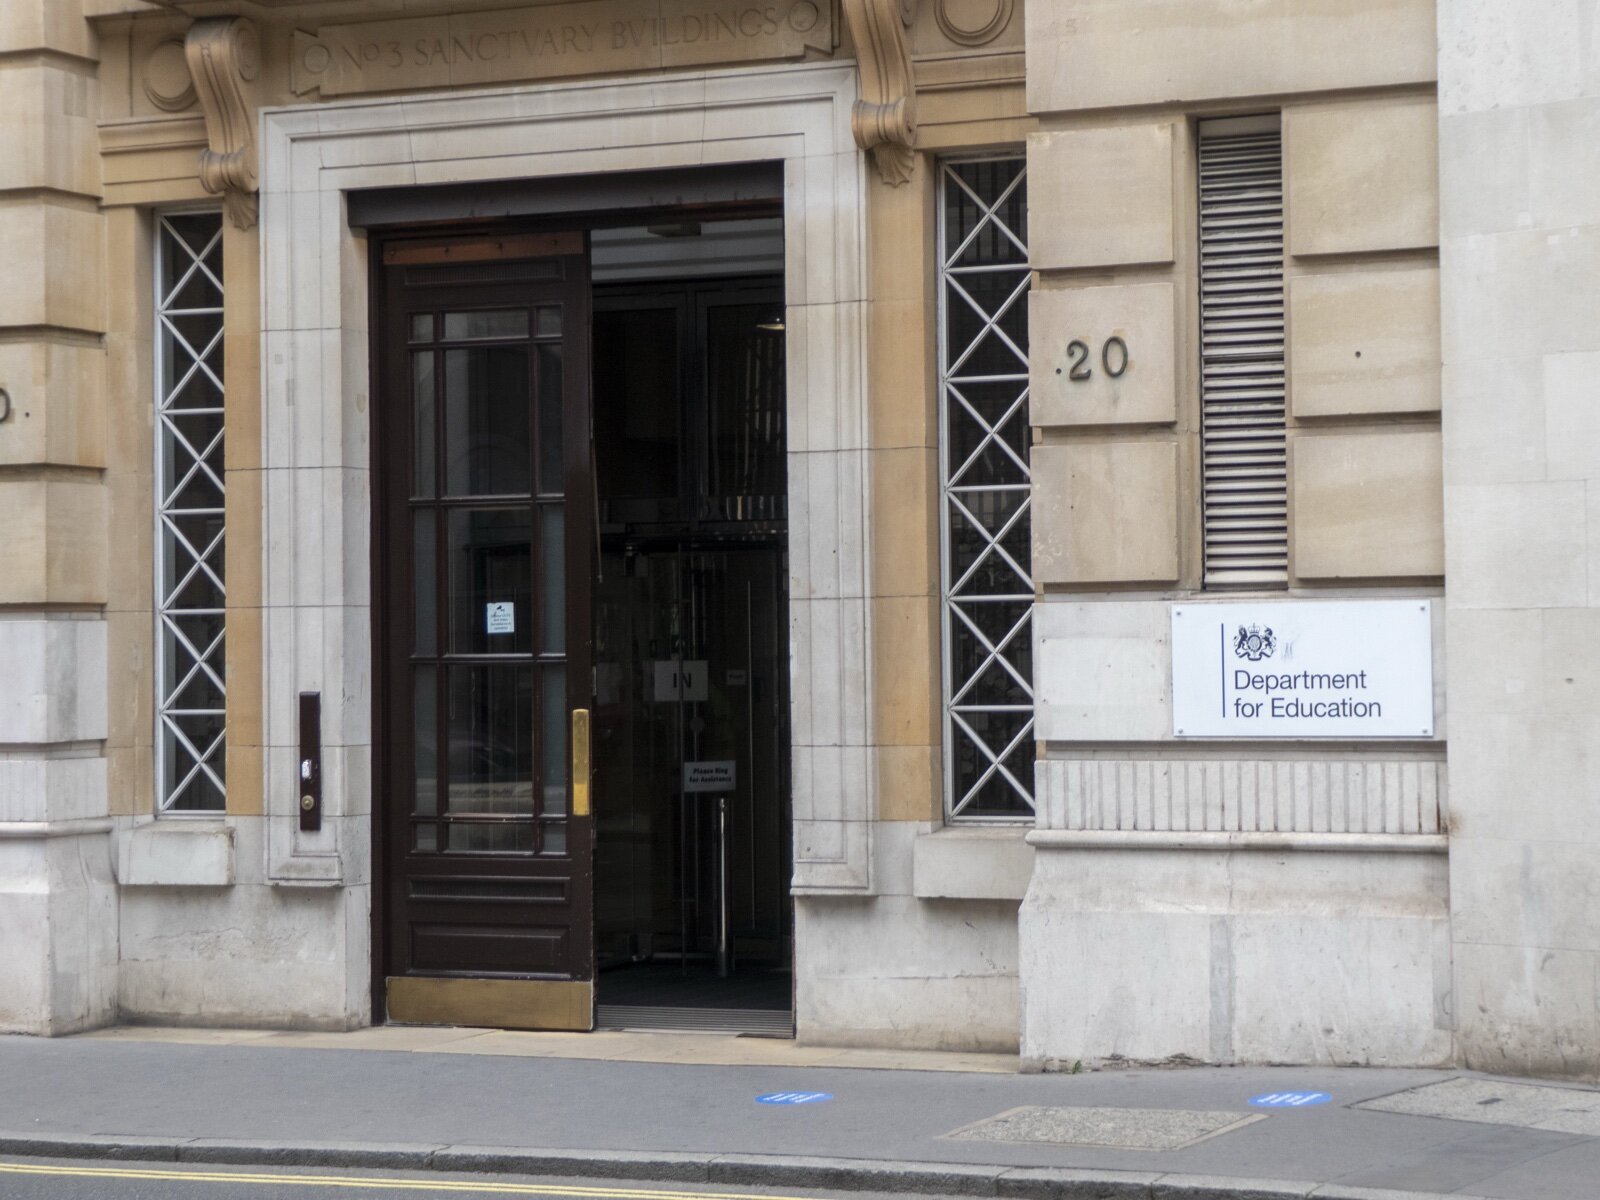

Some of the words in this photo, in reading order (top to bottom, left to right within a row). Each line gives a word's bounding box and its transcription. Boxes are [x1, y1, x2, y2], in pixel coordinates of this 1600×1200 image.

[387, 41, 404, 68] 3
[415, 23, 598, 67] SANCTVARY
[611, 7, 778, 50] BVILDINGS
[1066, 336, 1129, 381] 20
[673, 672, 692, 689] IN
[1234, 669, 1368, 695] Department
[1233, 697, 1264, 718] for
[1270, 697, 1383, 718] Education
